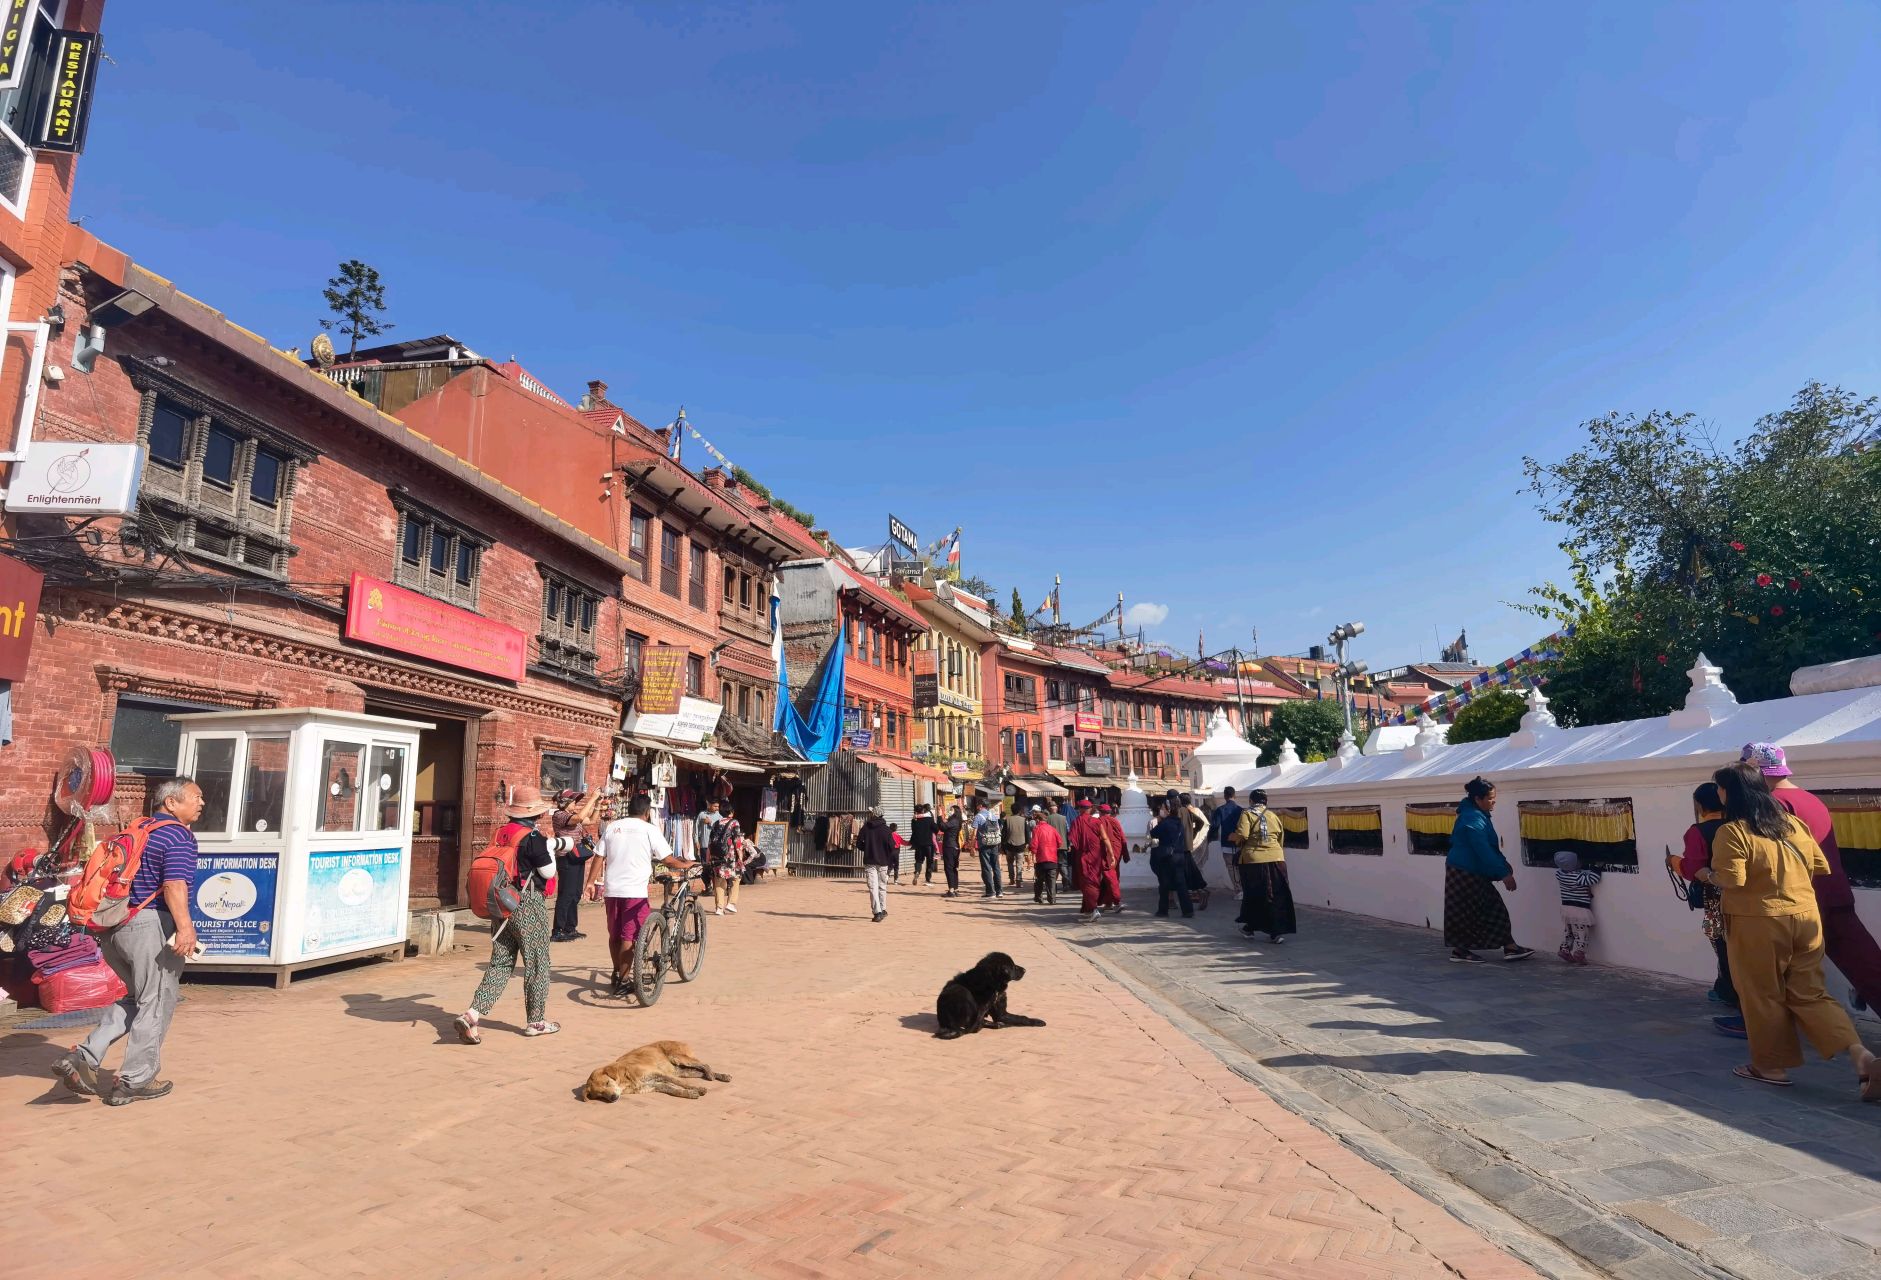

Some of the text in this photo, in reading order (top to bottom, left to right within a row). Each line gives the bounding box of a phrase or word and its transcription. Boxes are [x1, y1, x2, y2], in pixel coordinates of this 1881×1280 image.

[55, 42, 82, 136] RESTAURANT
[891, 519, 918, 551] GOTAMA
[894, 567, 921, 575] Gotama
[197, 858, 277, 869] RIST INFORMATION DESK
[311, 852, 400, 869] TOURIST INFORMATION DESK
[222, 899, 243, 911] Nepal
